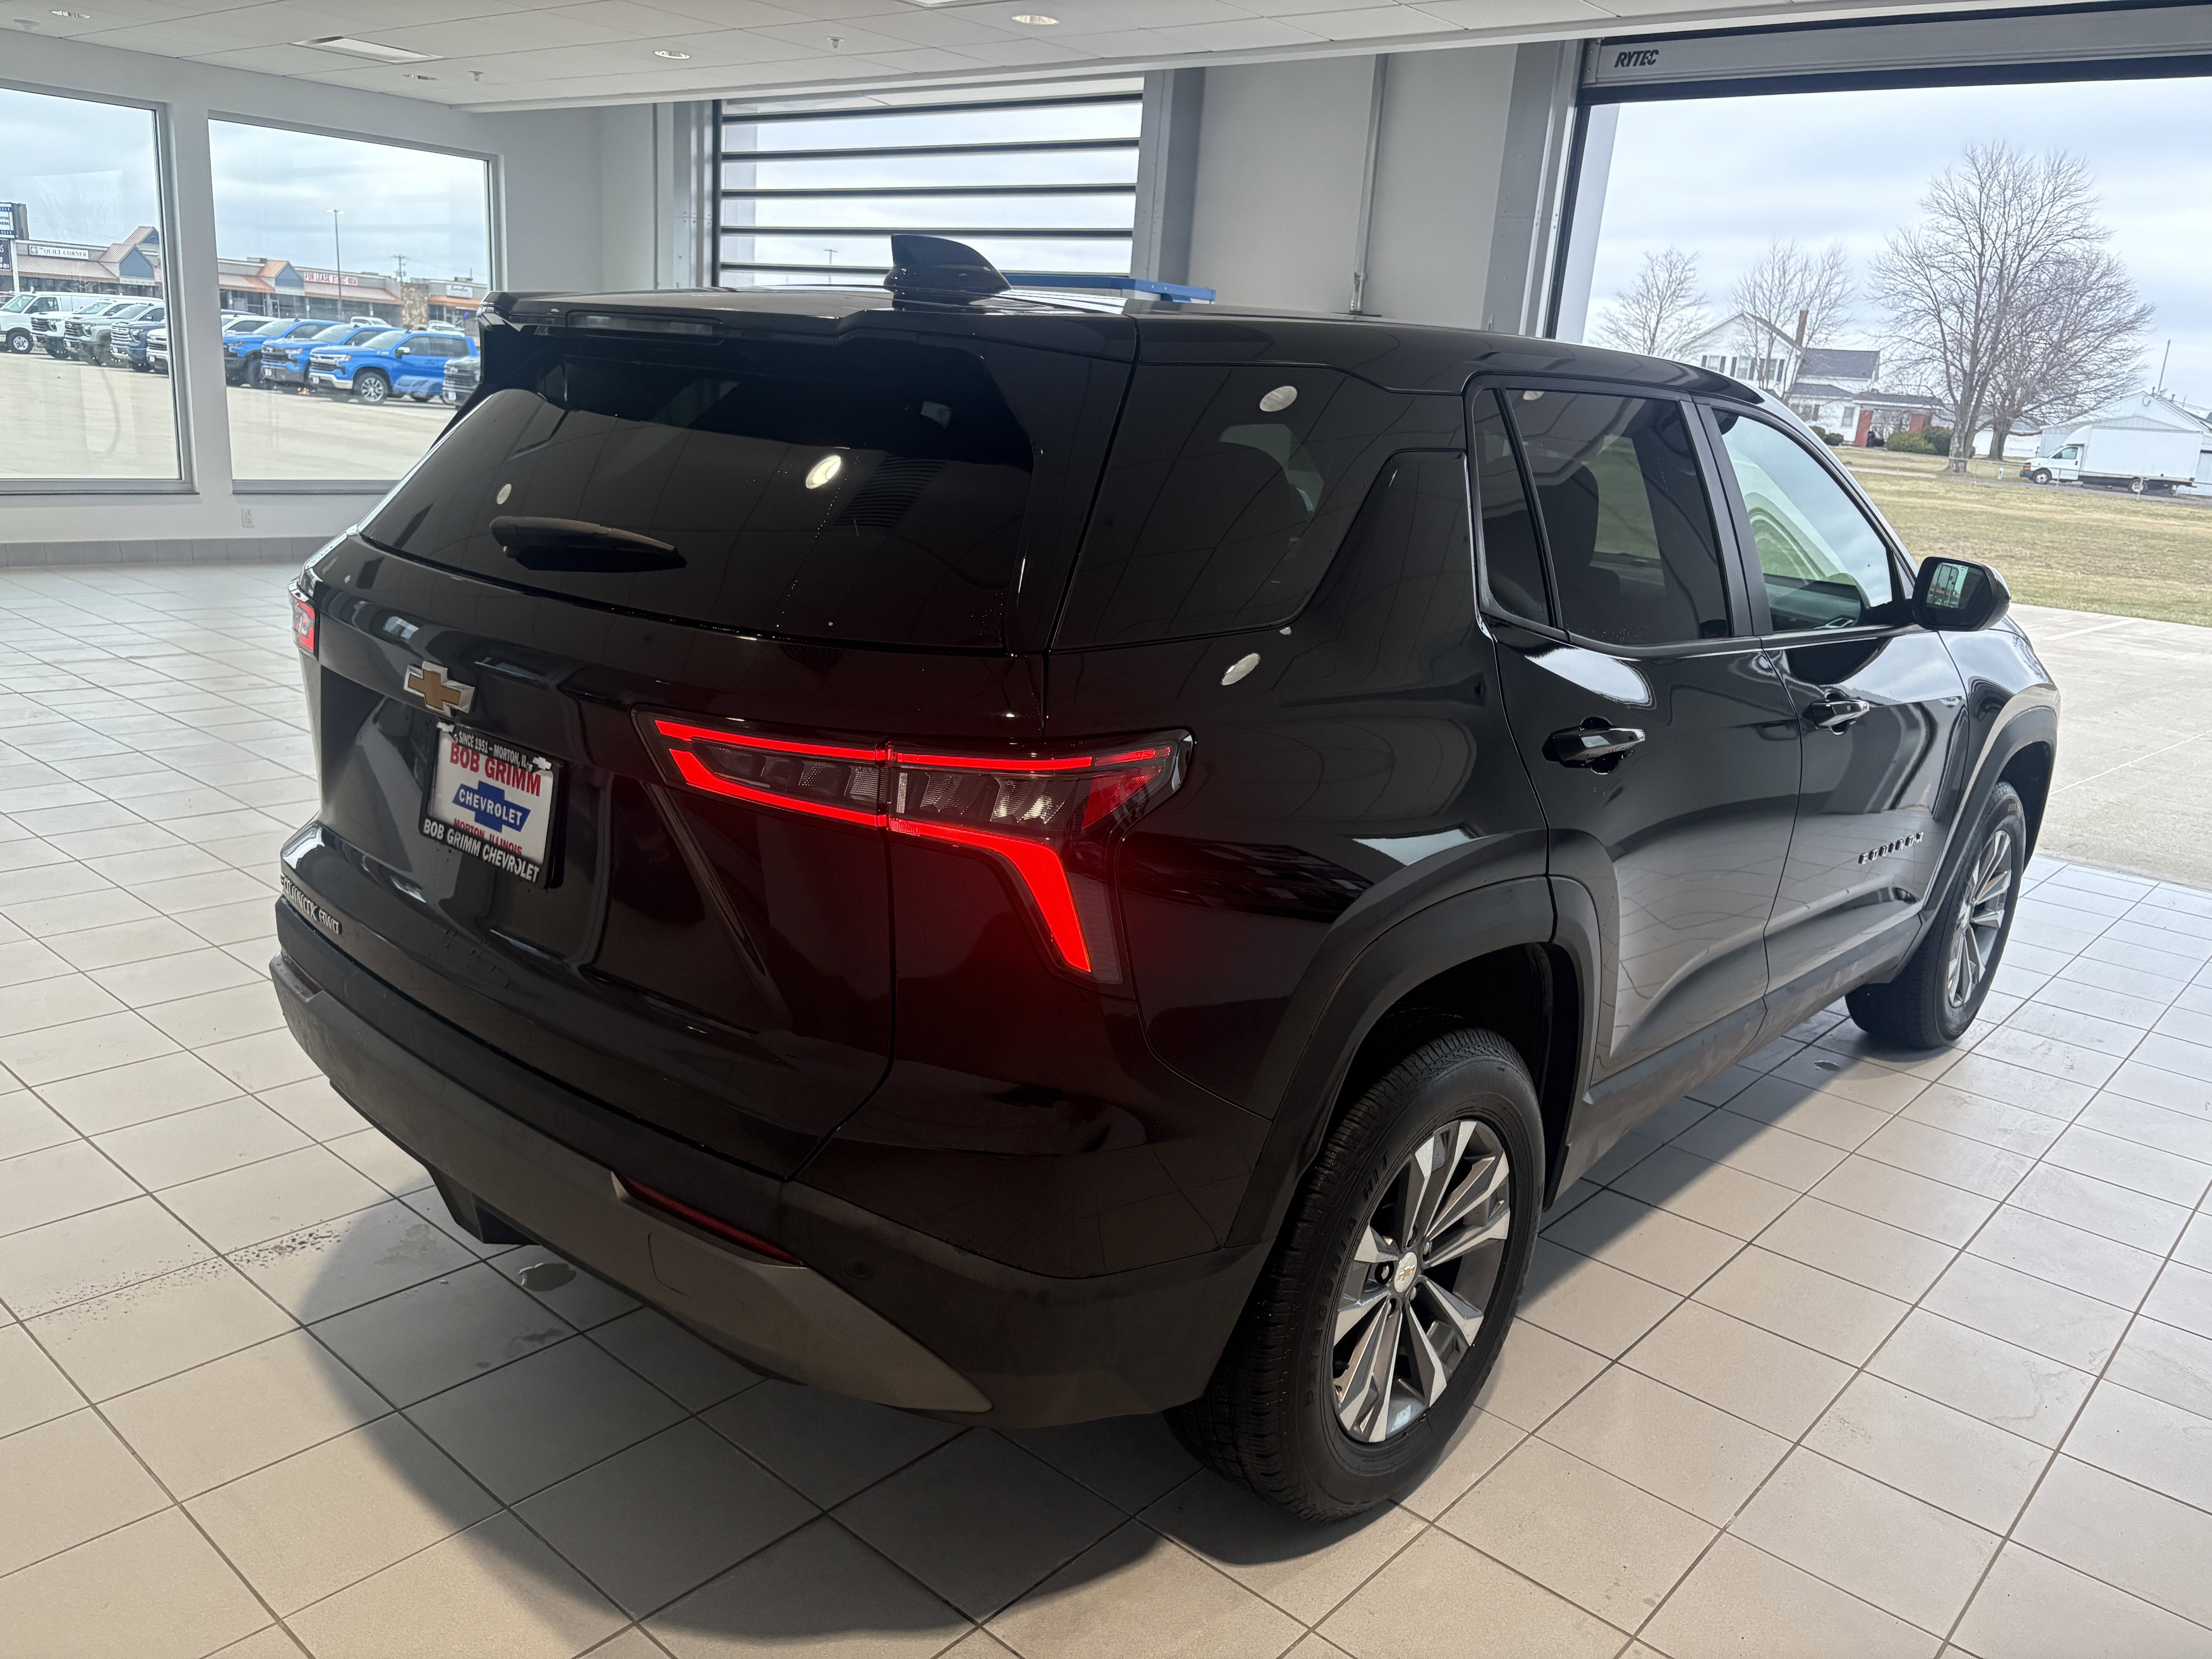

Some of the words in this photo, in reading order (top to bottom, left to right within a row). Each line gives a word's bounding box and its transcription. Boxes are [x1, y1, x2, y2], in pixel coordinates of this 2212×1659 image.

[1614, 49, 1659, 67] RYTEC
[459, 730, 474, 748] SINCE
[474, 737, 488, 754] 1951
[493, 744, 520, 768] MORTON,
[450, 742, 480, 773] BOB
[485, 757, 541, 797] GRIMM
[459, 788, 522, 826] CHEVROLET
[423, 818, 445, 840] BOB
[447, 828, 481, 857] GRIMM
[483, 844, 540, 883] CHEVROLET
[319, 909, 340, 934] AWD
